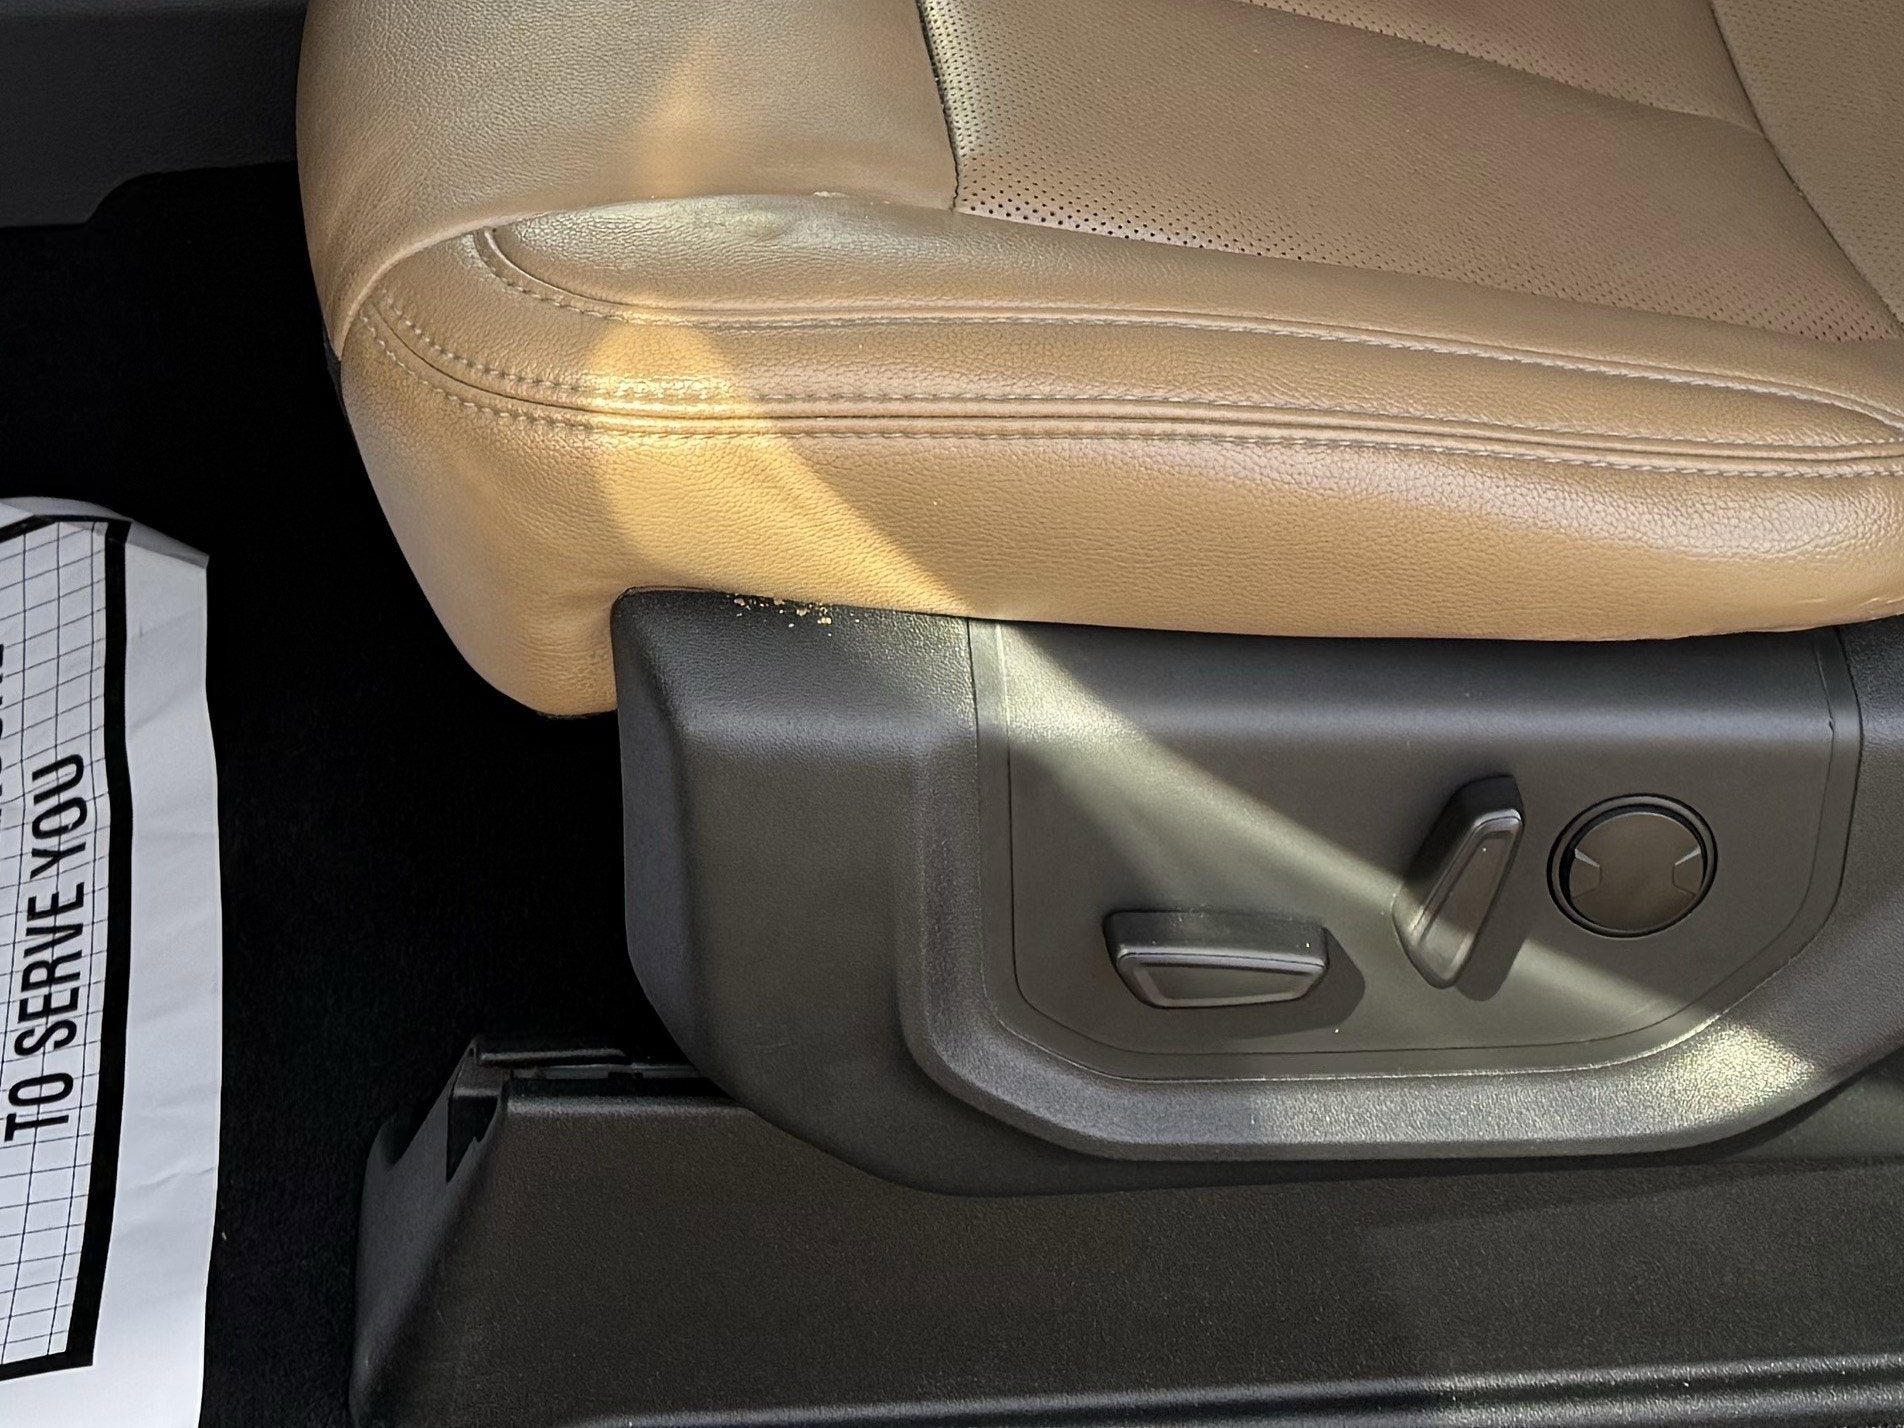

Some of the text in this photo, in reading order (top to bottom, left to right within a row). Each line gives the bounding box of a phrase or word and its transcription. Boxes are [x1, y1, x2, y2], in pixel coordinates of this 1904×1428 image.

[4, 753, 88, 1142] TO SERVE YOU
